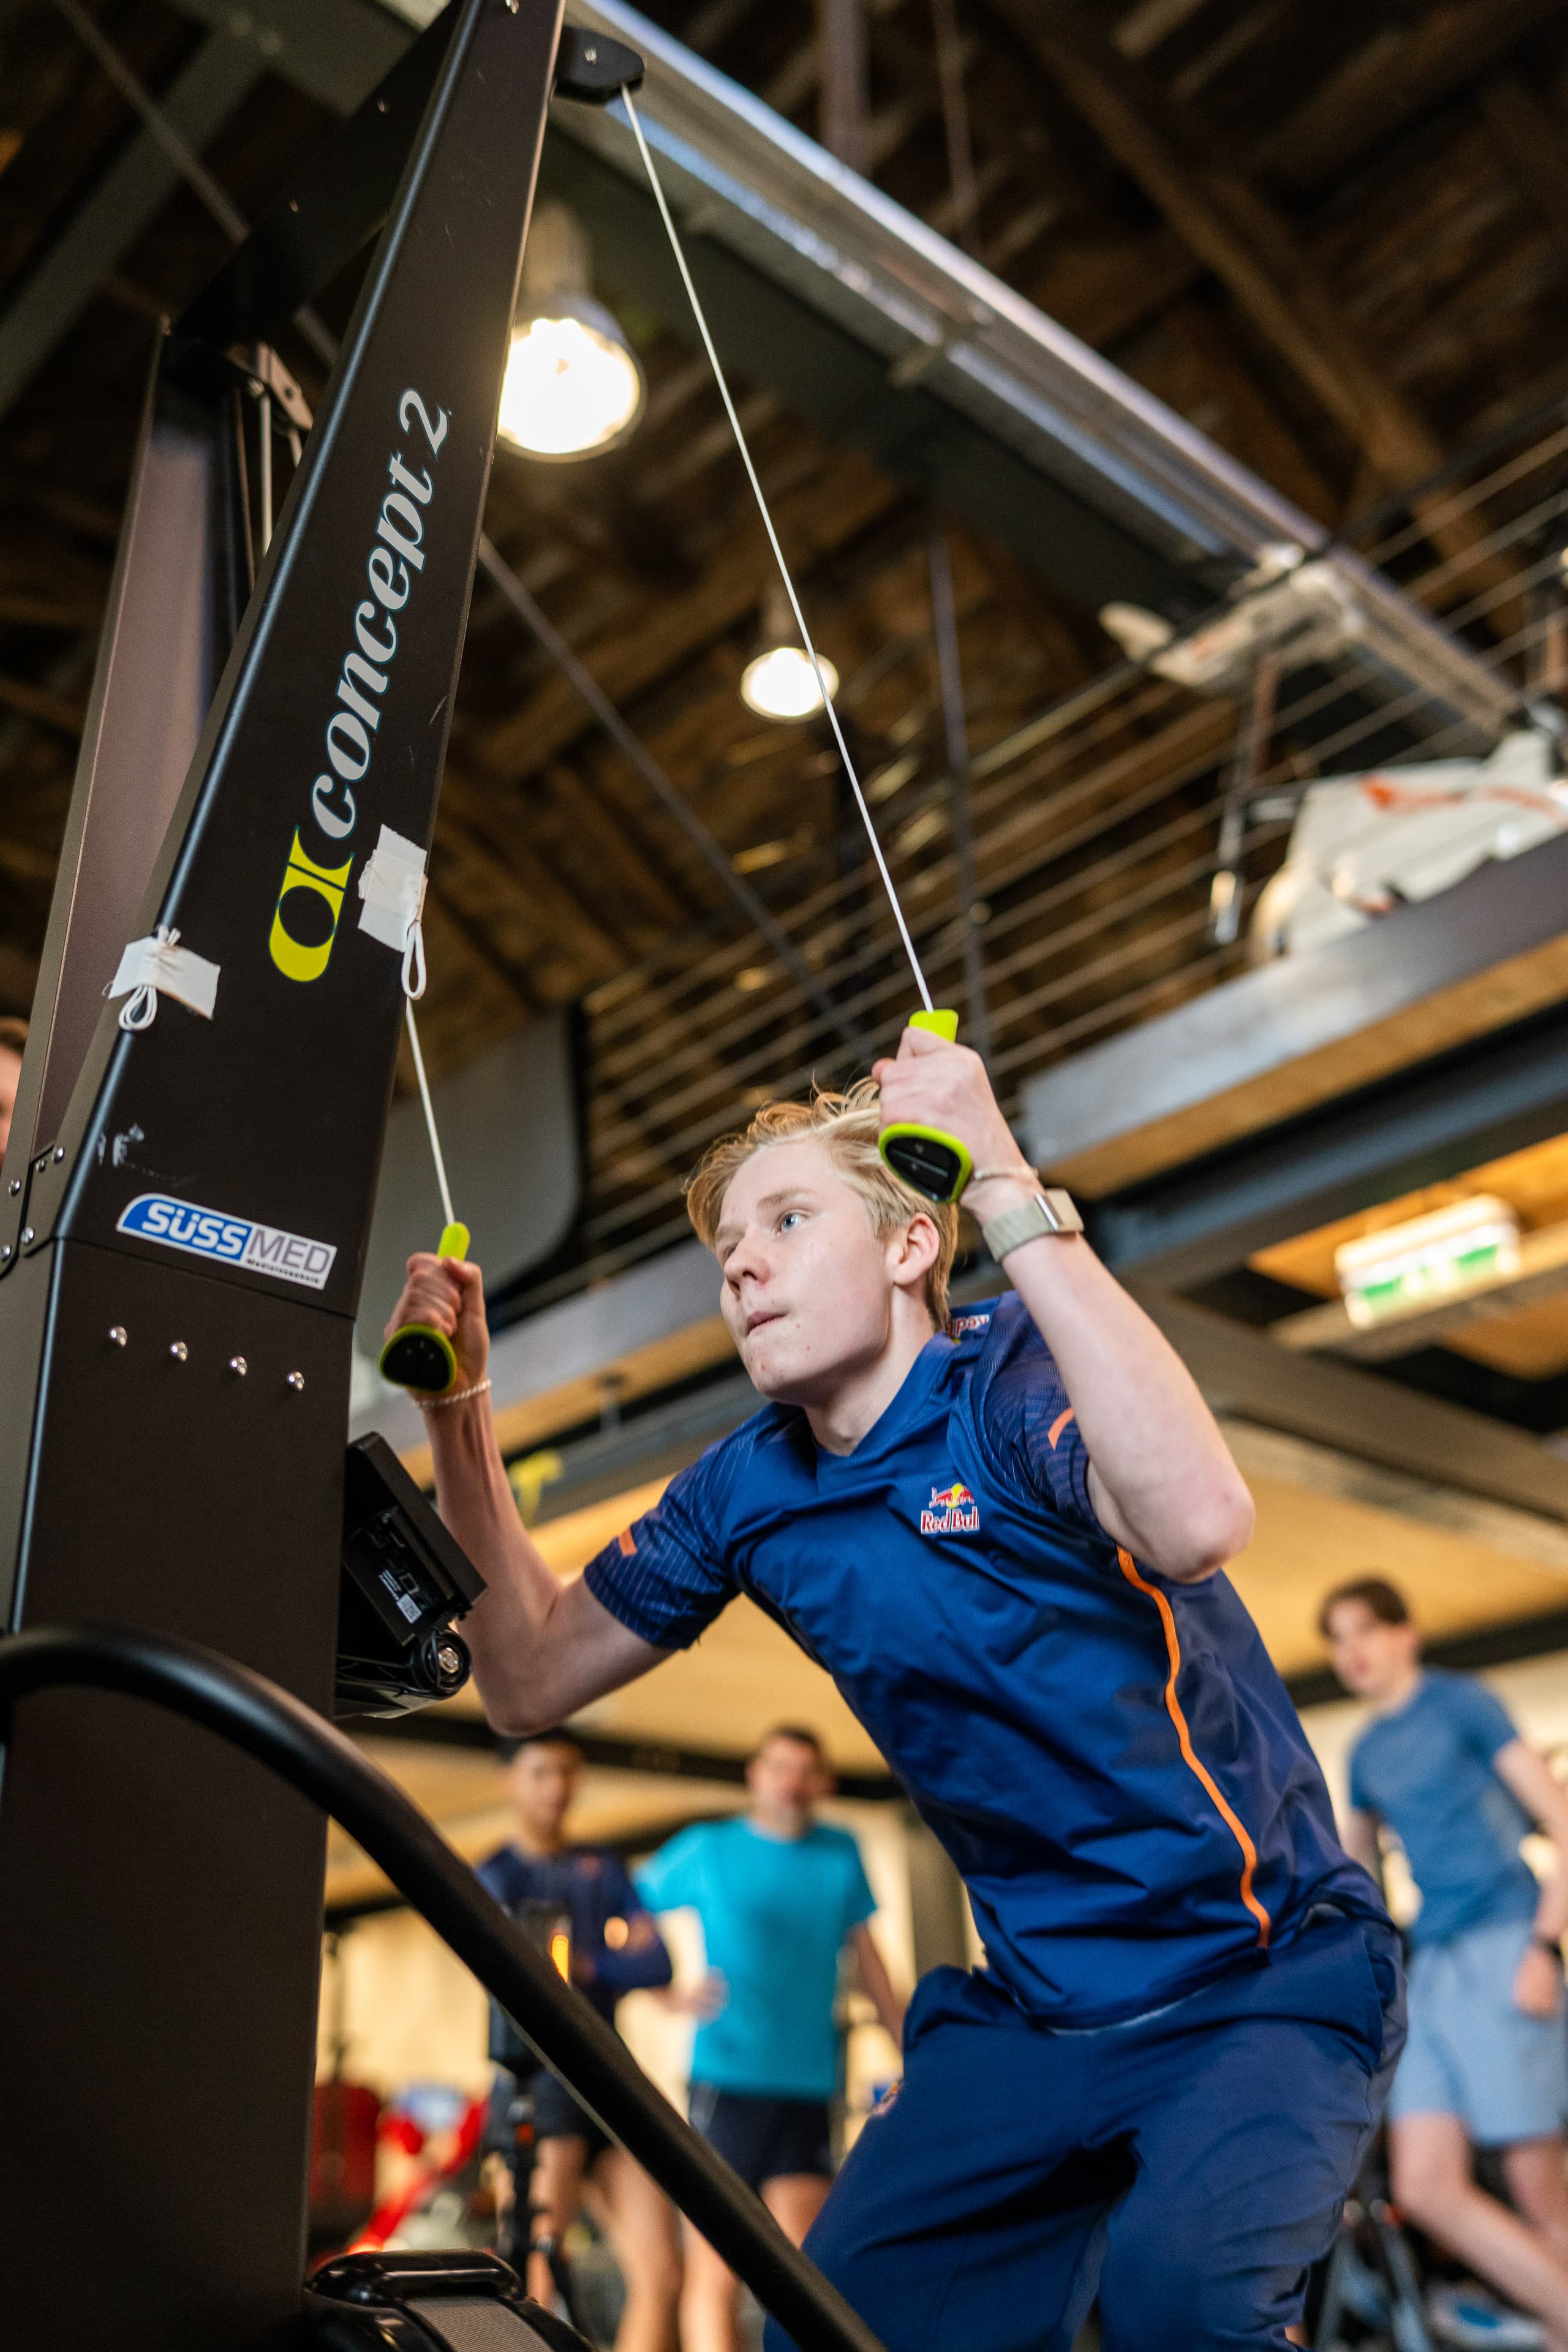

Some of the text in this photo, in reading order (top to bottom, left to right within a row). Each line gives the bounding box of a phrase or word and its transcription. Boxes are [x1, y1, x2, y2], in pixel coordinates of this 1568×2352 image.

[311, 388, 450, 840] concept 2
[921, 1507, 951, 1534] Red
